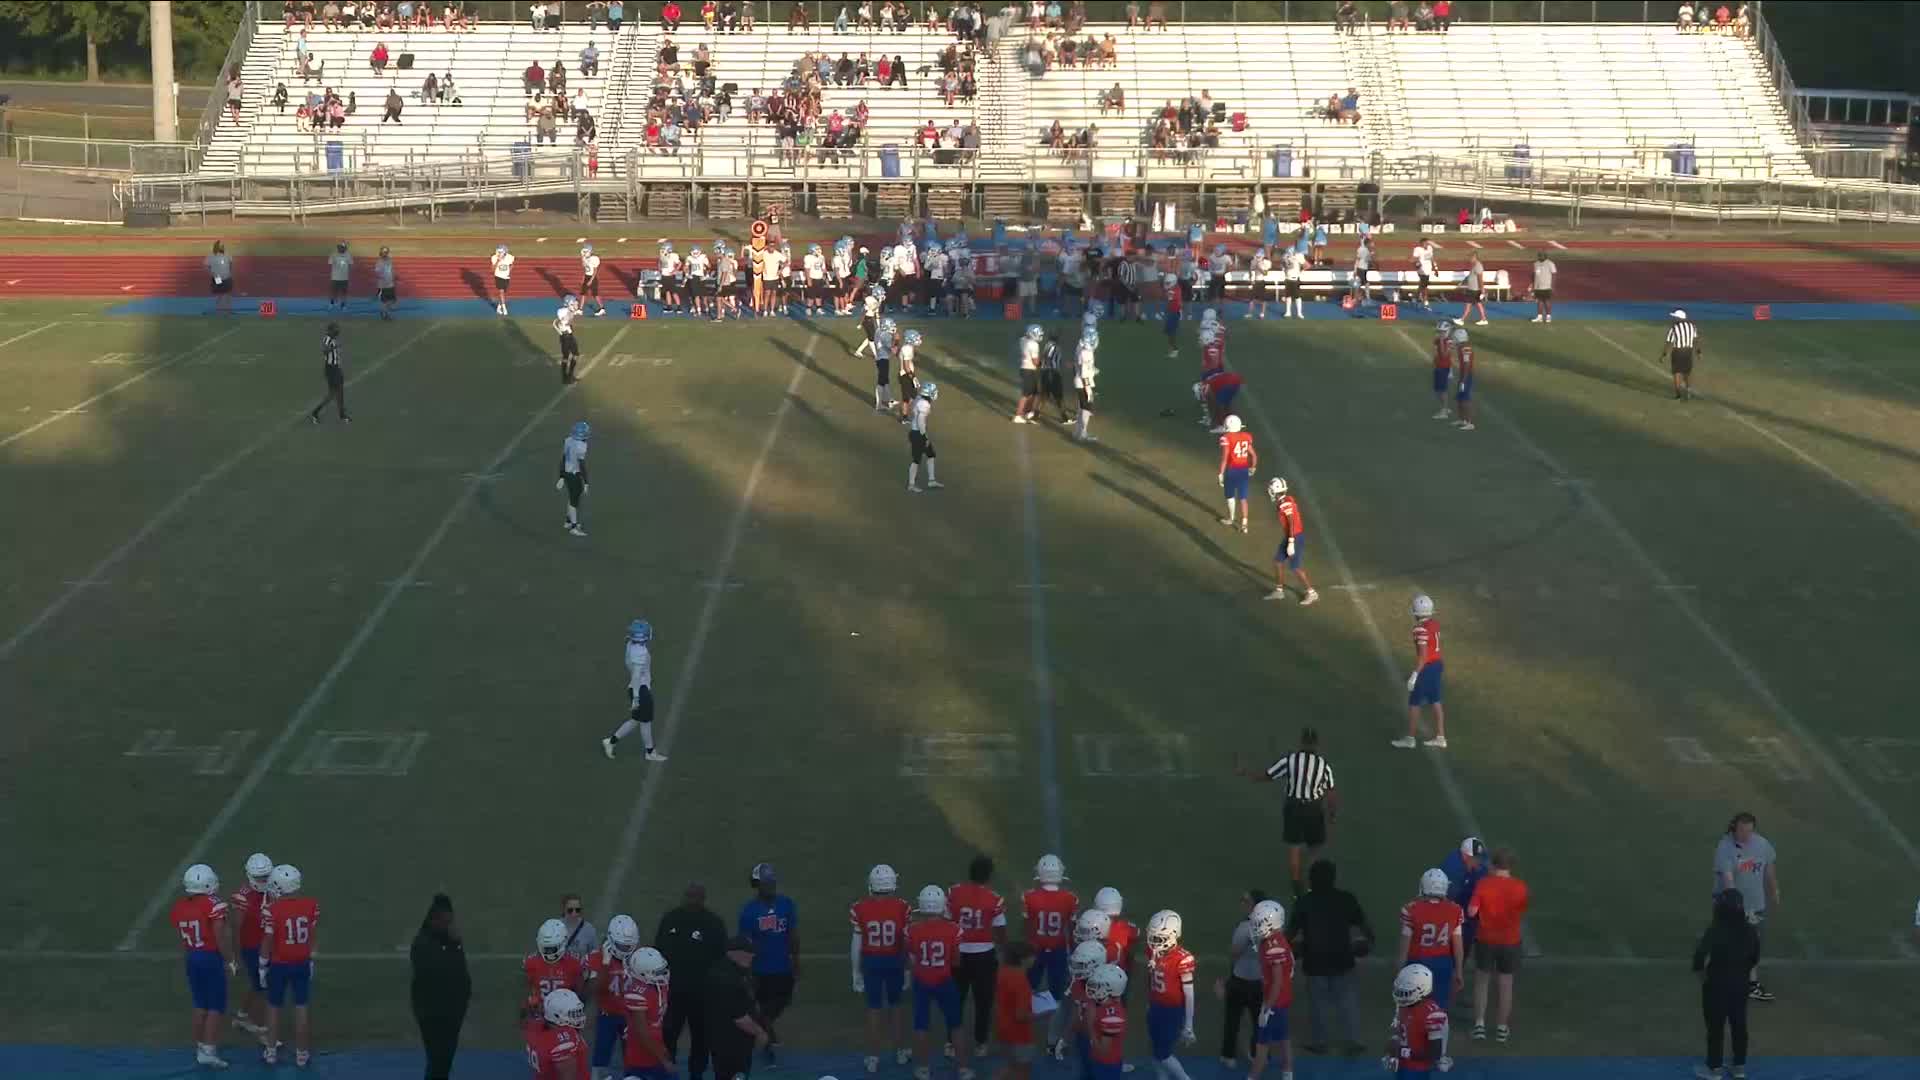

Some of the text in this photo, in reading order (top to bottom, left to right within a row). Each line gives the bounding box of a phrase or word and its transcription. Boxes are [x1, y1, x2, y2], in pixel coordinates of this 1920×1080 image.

[1233, 441, 1249, 458] 42
[285, 916, 308, 946] 16
[959, 906, 985, 930] 21
[1036, 910, 1061, 937] 19
[178, 919, 206, 948] 57
[866, 921, 897, 947] 28
[1420, 923, 1450, 948] 24
[919, 941, 945, 967] 12
